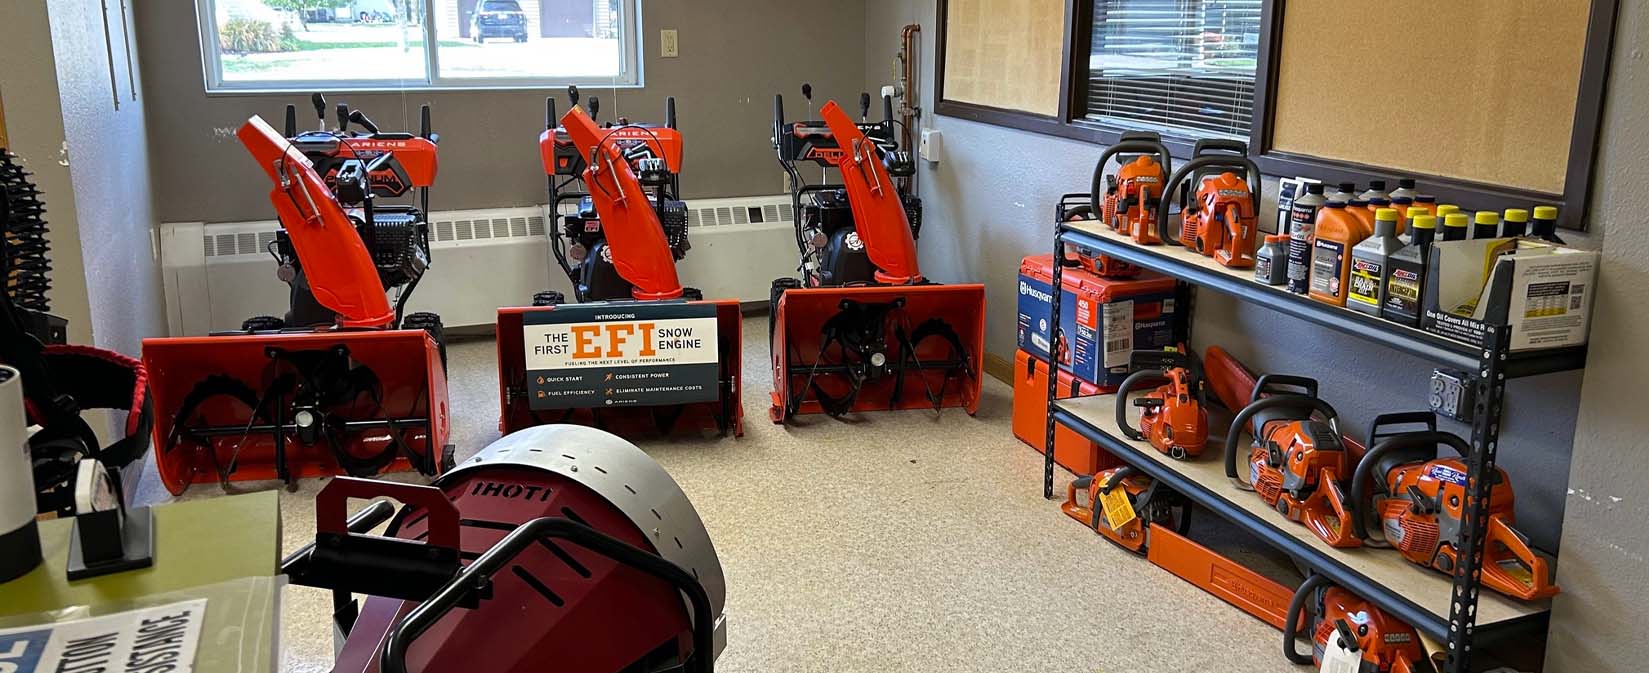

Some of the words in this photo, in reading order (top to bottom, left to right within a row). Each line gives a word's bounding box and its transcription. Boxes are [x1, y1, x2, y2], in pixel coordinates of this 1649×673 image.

[1426, 310, 1436, 319] One
[1444, 314, 1461, 325] Covers
[1461, 318, 1469, 327] All
[1470, 320, 1480, 330] Mix
[544, 333, 568, 343] THE
[658, 327, 693, 338] SNOW
[570, 322, 657, 359] EFI
[658, 339, 701, 350] ENGINE
[534, 344, 569, 355] FIRST
[471, 482, 553, 502] IHOTI
[55, 632, 119, 673] TTON
